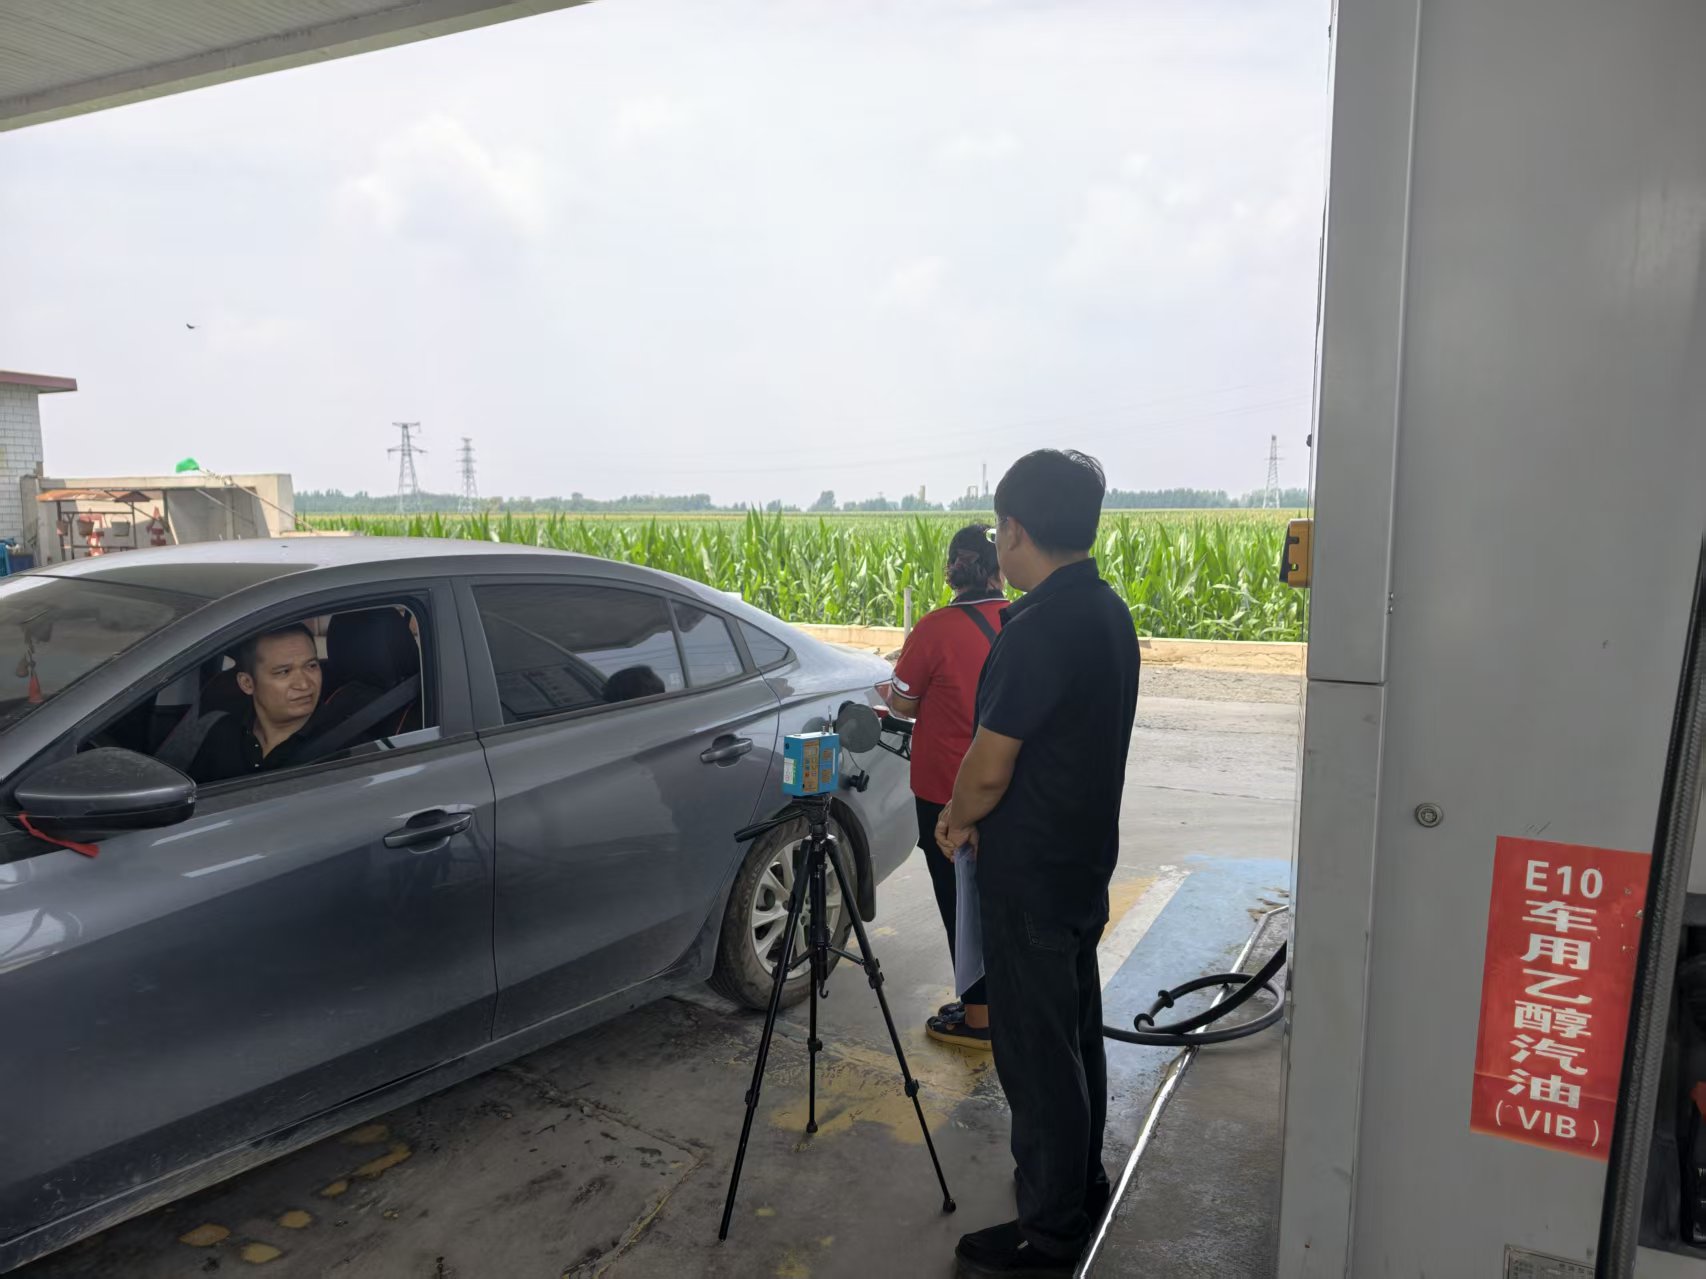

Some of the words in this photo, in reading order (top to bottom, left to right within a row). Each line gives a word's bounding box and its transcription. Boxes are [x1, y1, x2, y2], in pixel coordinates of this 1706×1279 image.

[1525, 859, 1603, 899] E10
[1507, 899, 1598, 1109] 车用乙醇汽油
